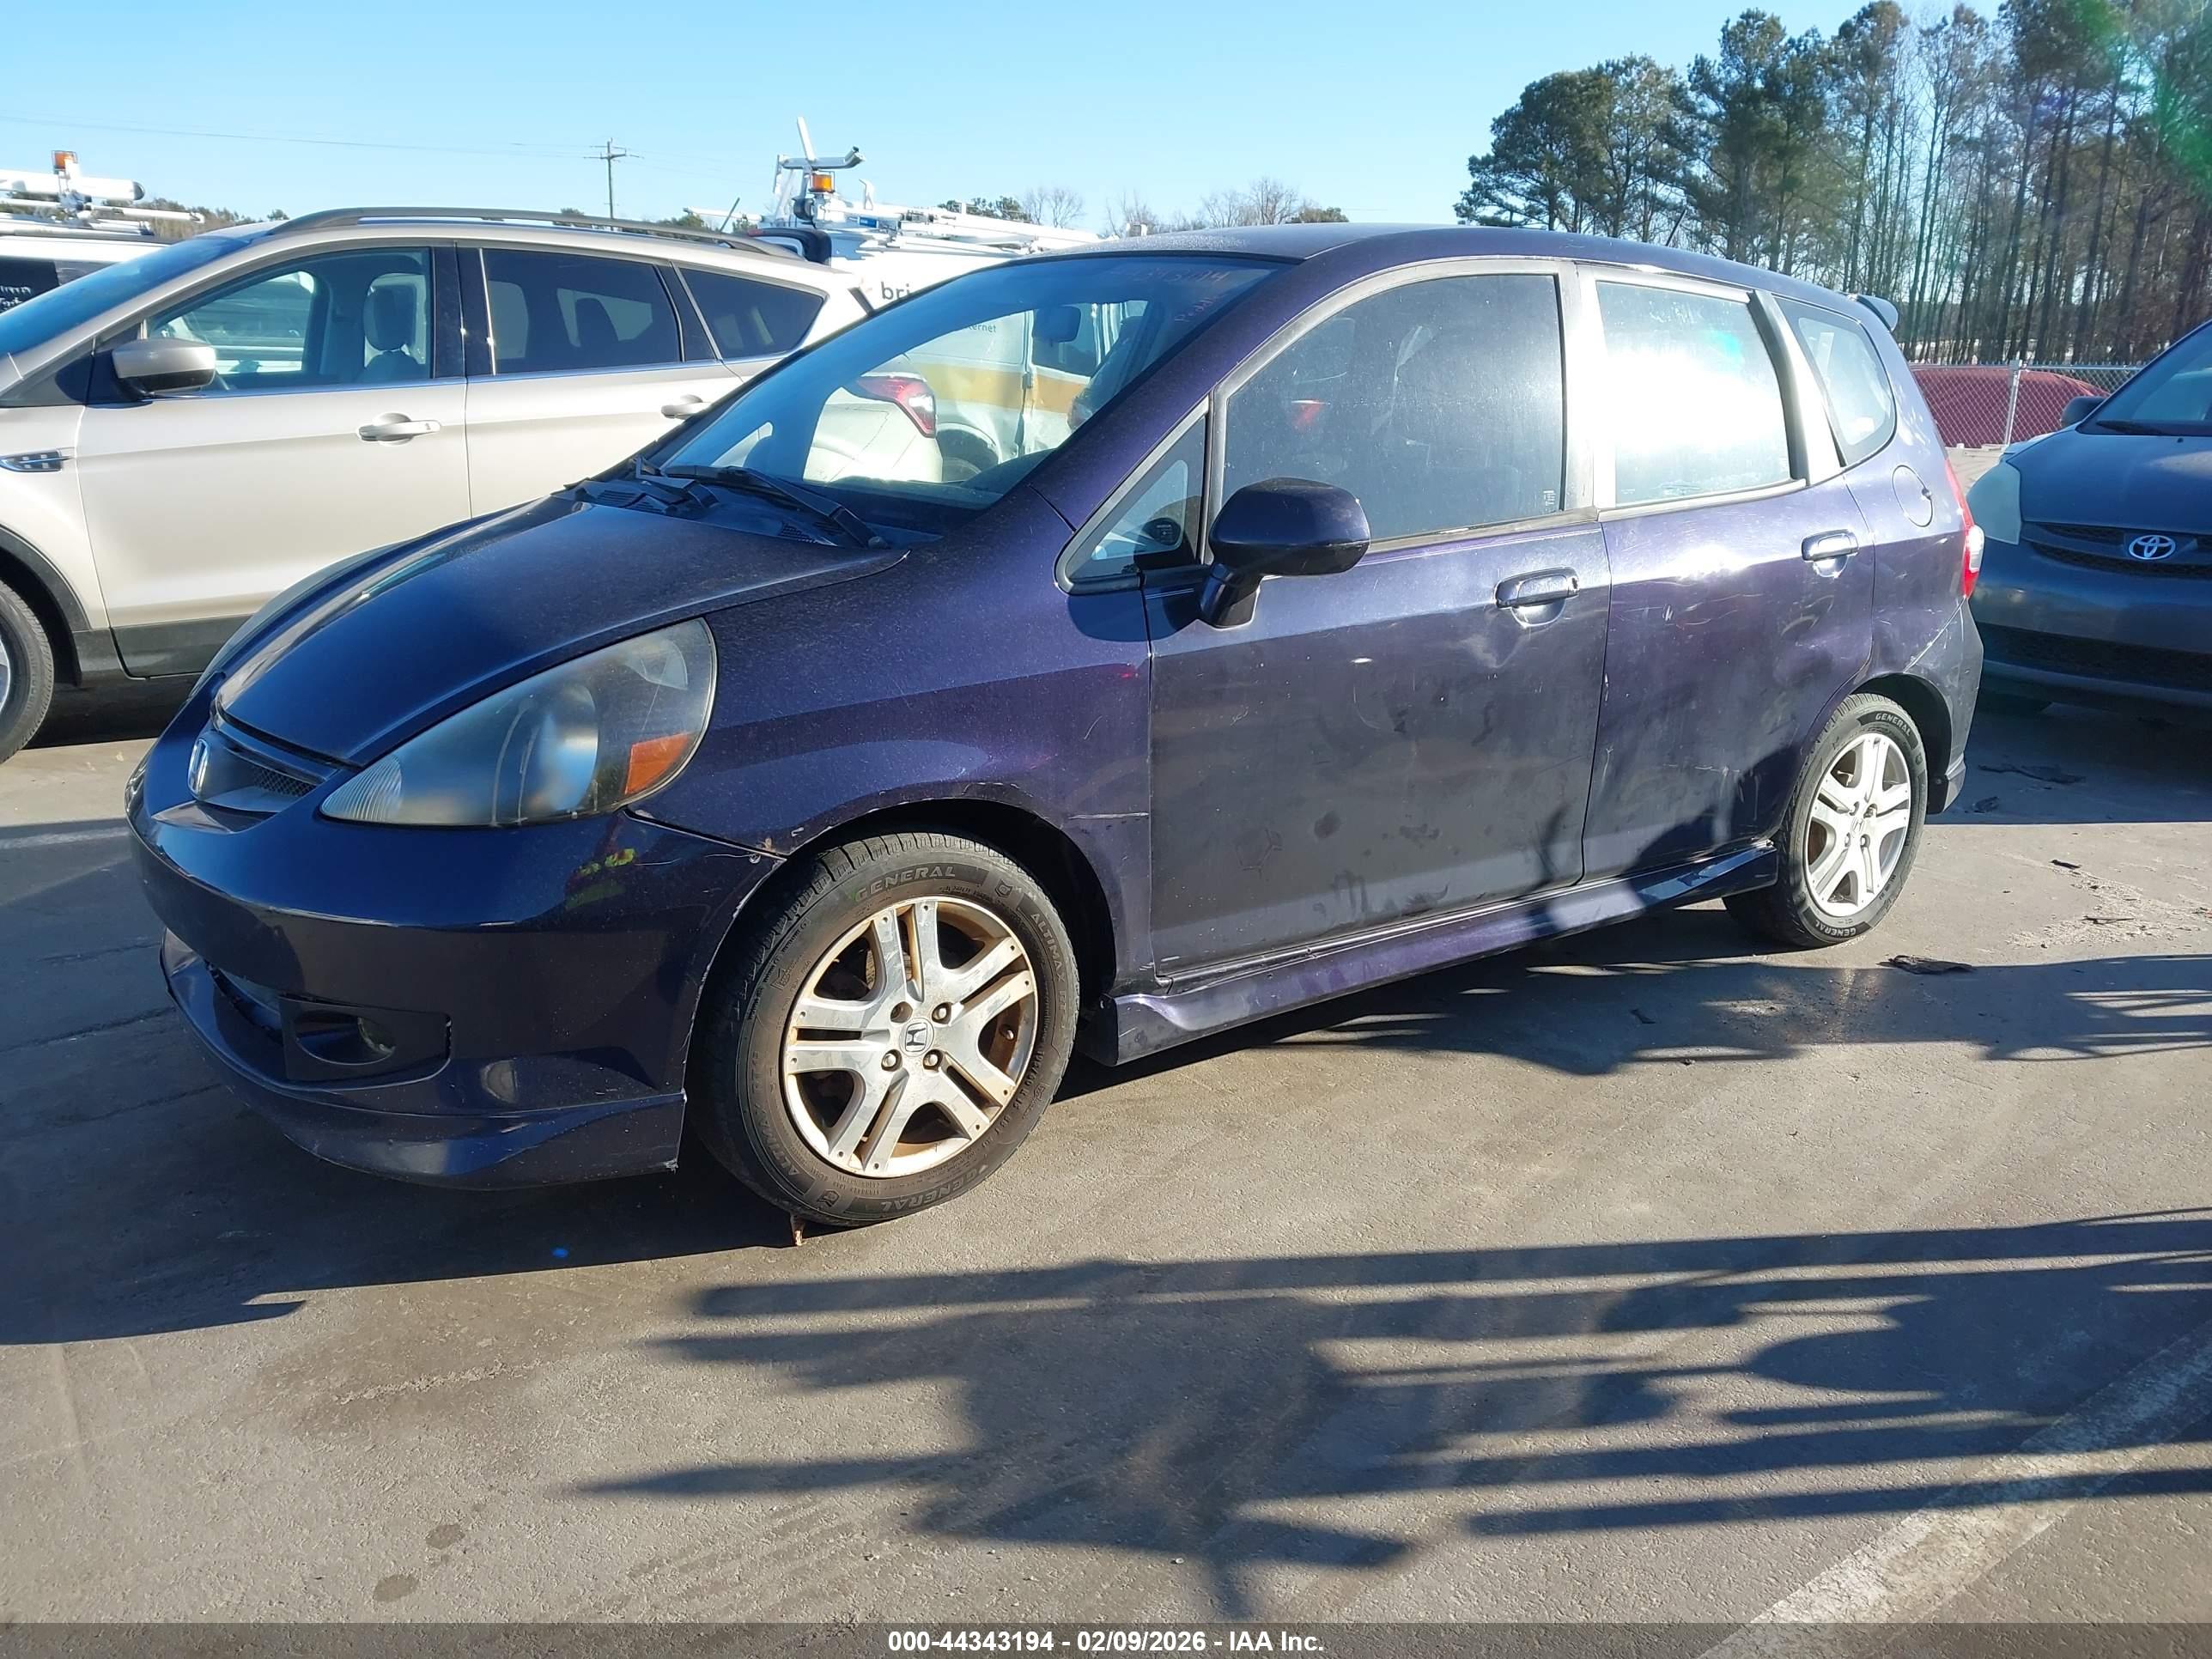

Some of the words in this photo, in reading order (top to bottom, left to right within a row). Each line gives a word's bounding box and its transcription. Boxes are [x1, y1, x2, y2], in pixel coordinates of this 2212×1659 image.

[1875, 713, 1911, 737] GENERAL
[855, 866, 956, 902] GENERAL
[1814, 919, 1856, 937] GENERAL
[1030, 912, 1066, 984] ALTIMAX
[881, 1169, 978, 1212] GENERAL
